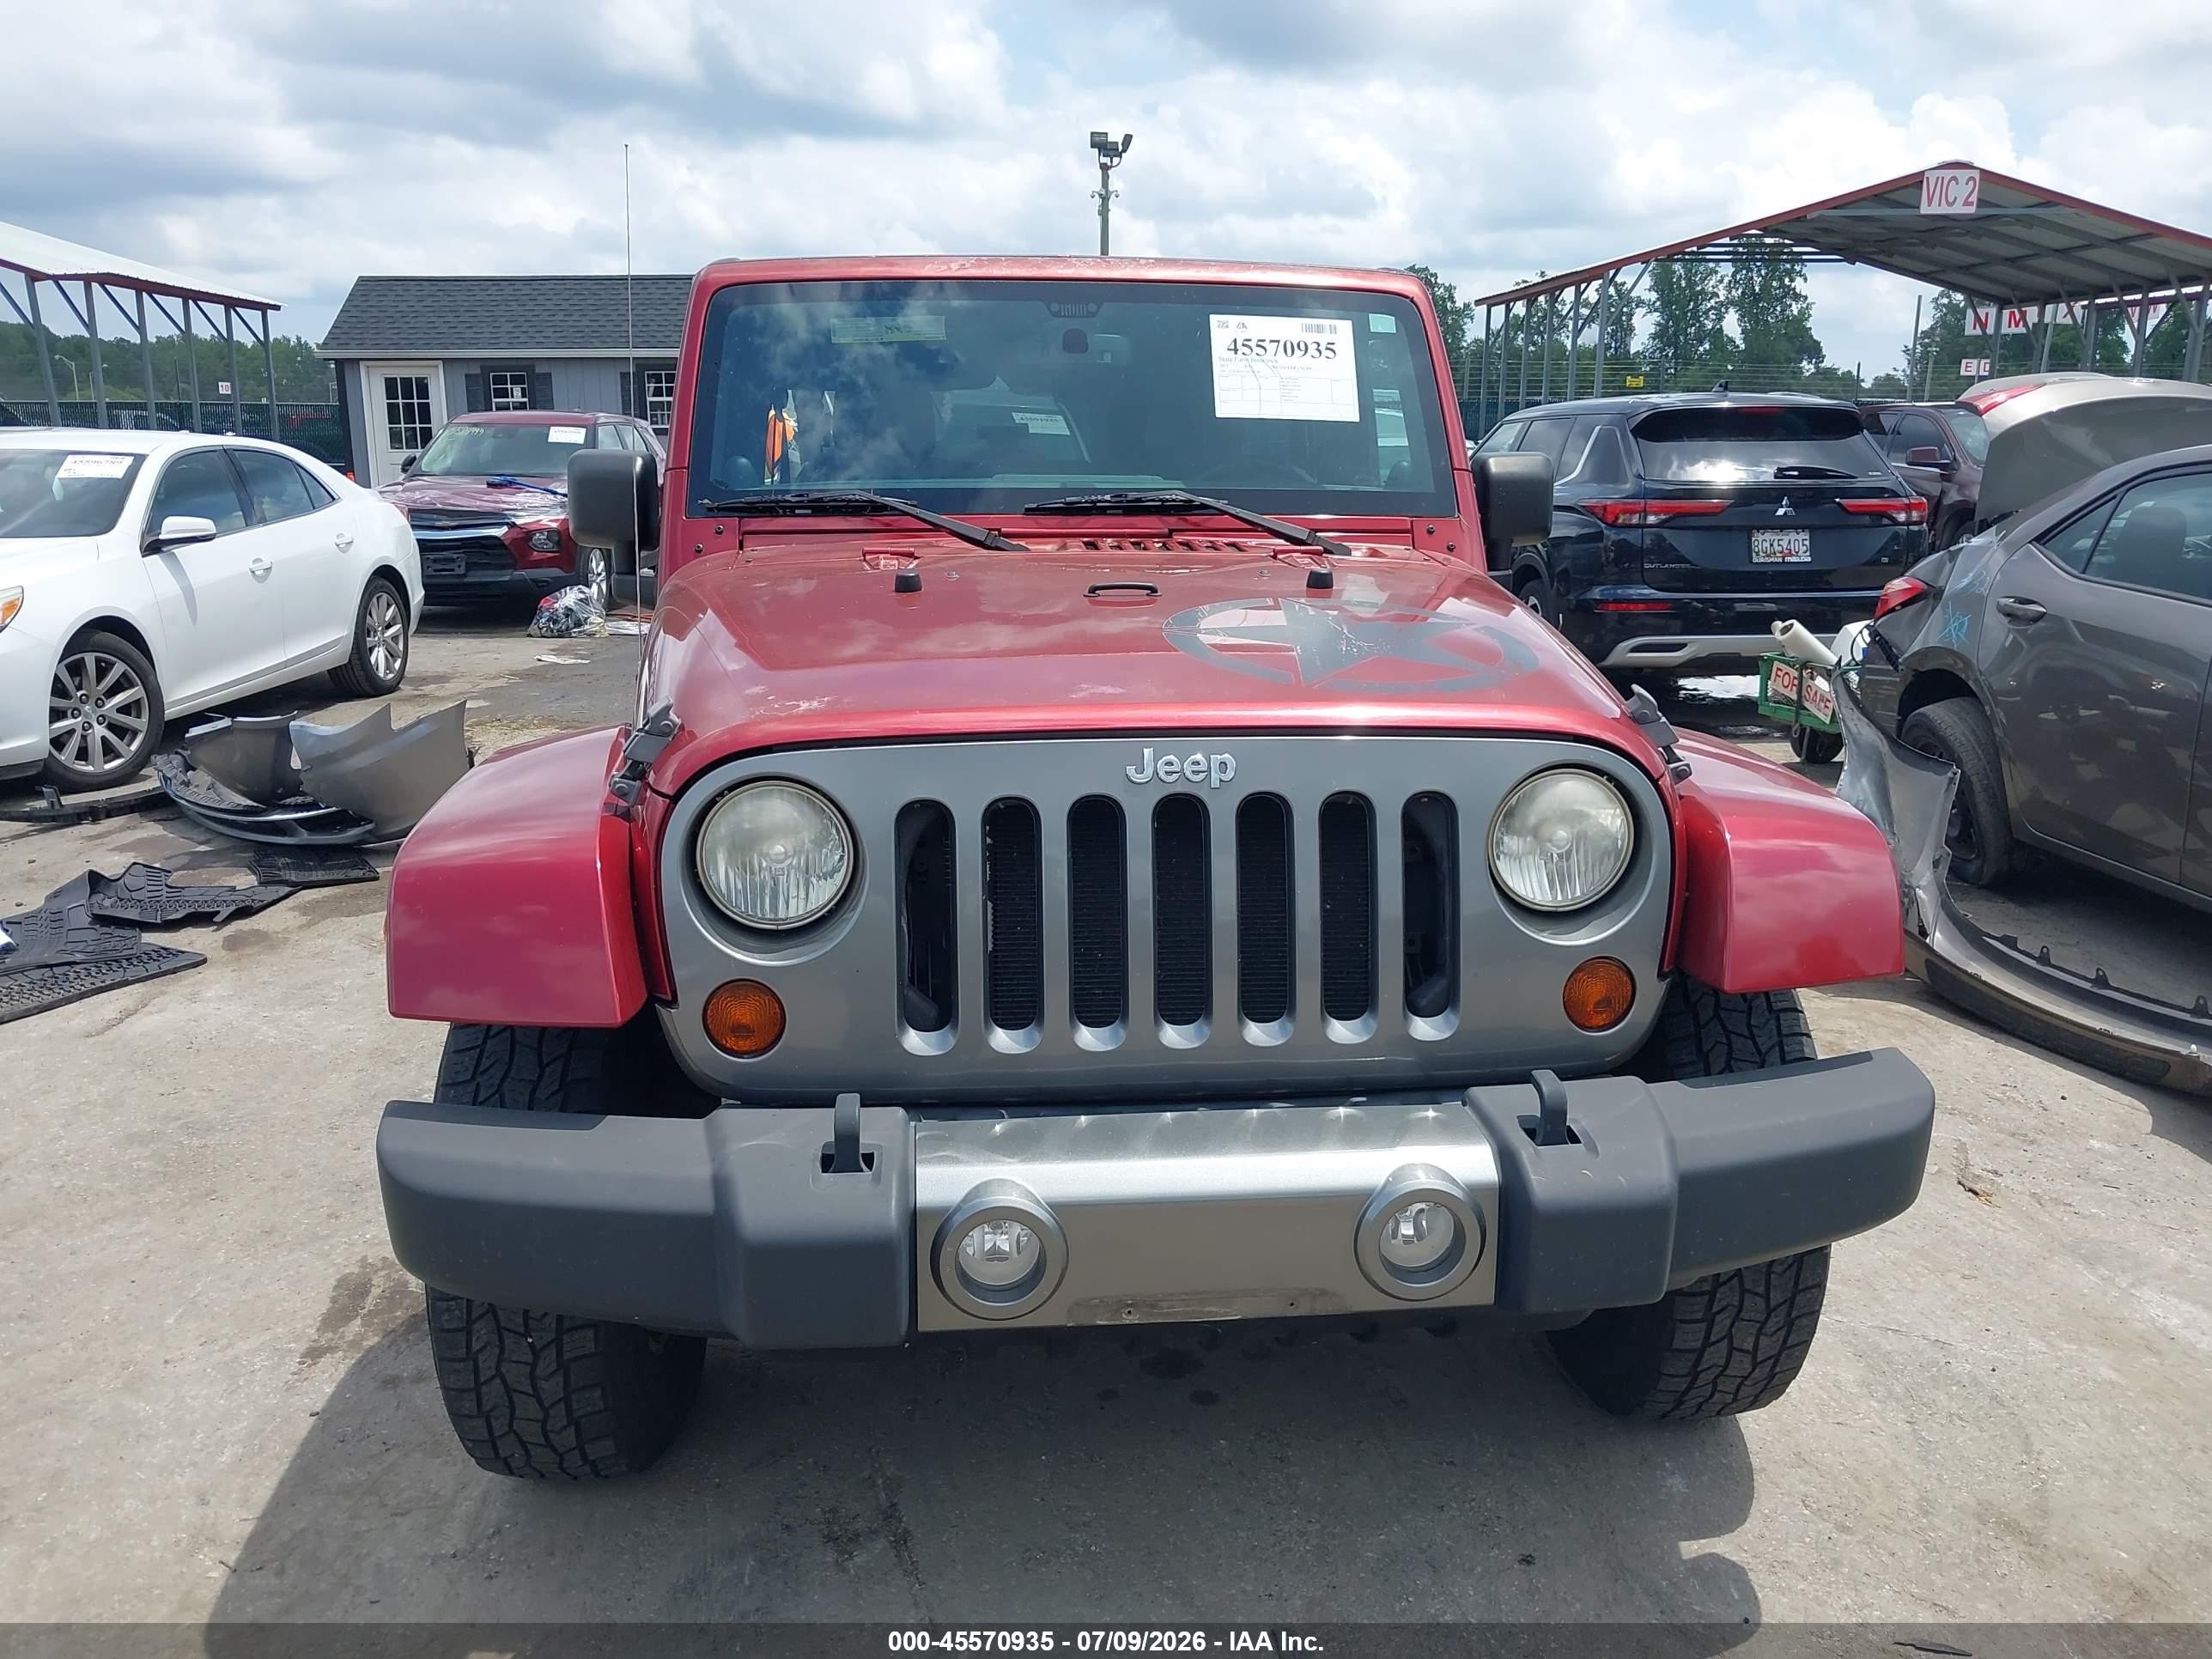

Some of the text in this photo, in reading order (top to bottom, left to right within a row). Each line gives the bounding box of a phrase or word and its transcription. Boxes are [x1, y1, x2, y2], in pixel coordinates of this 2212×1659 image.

[1925, 175, 1977, 208] VIC 2
[2008, 309, 2027, 329] M
[1226, 337, 1338, 360] 45570935
[1964, 362, 1973, 373] E
[1753, 538, 1809, 555] 8GK5405
[1126, 747, 1237, 789] Jeep
